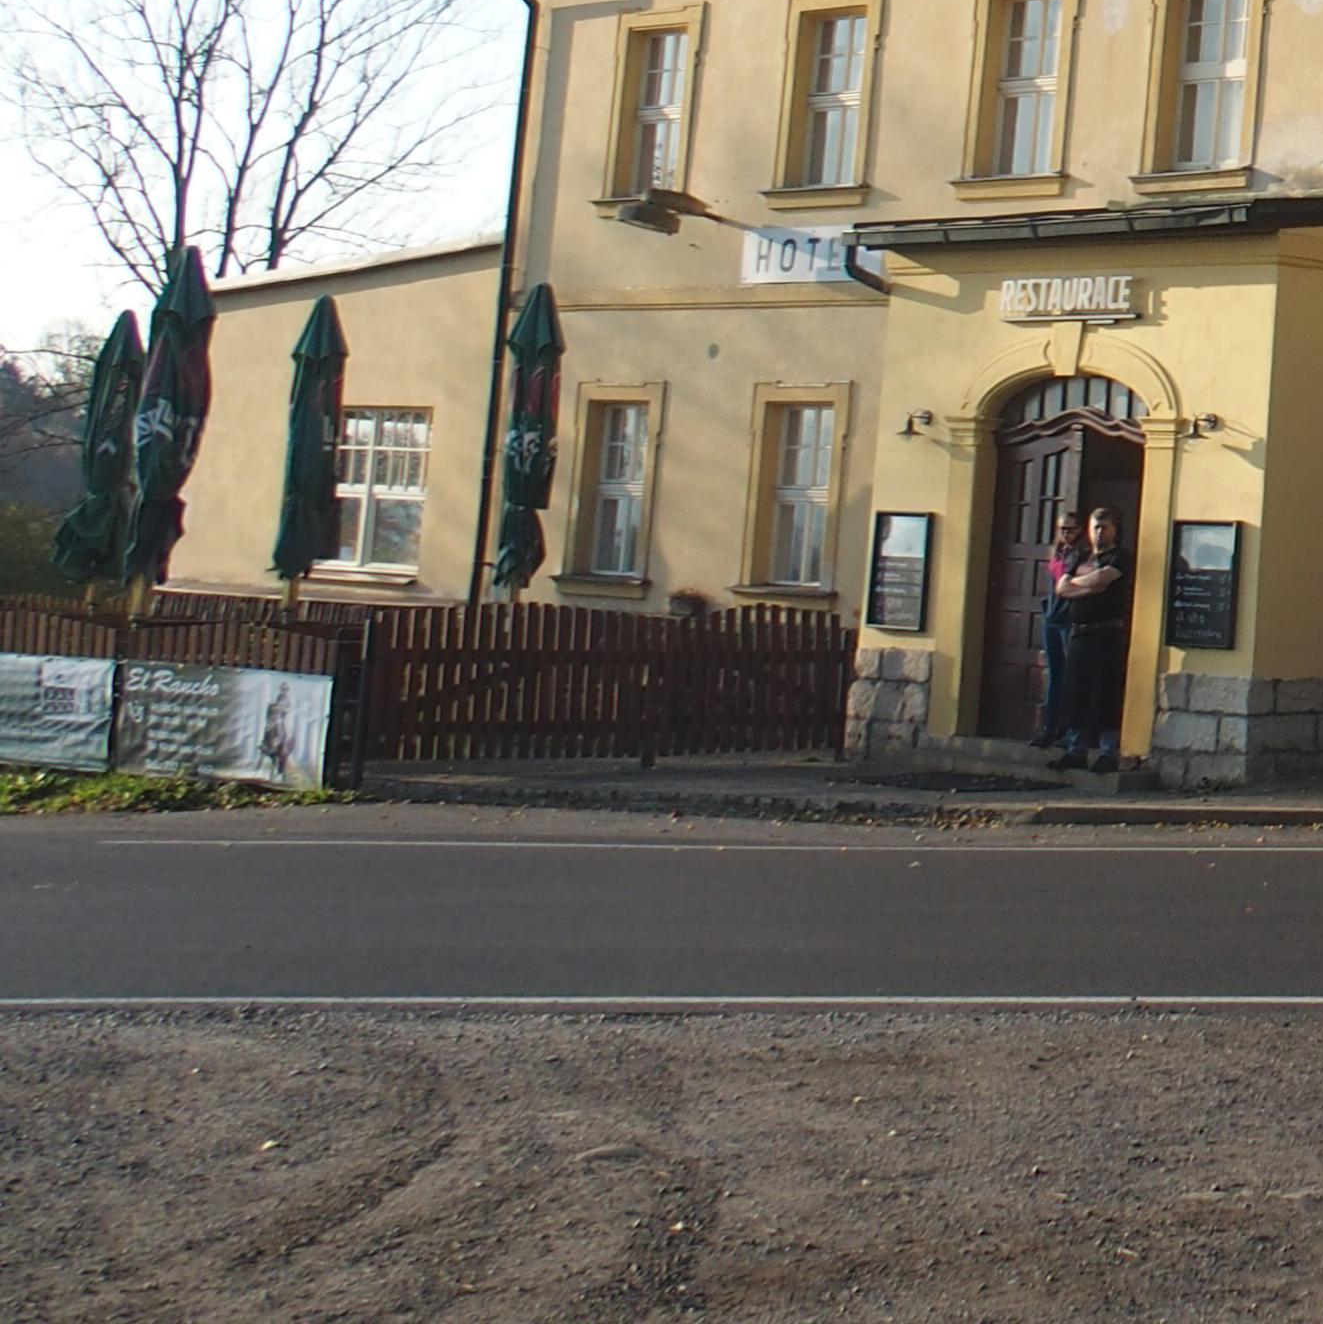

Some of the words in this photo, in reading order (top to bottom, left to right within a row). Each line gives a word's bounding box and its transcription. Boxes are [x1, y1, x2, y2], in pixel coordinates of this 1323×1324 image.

[755, 237, 844, 274] HOTE
[1001, 276, 1133, 312] RESTAURACE
[125, 667, 150, 692] El
[151, 669, 220, 696] Rancho
